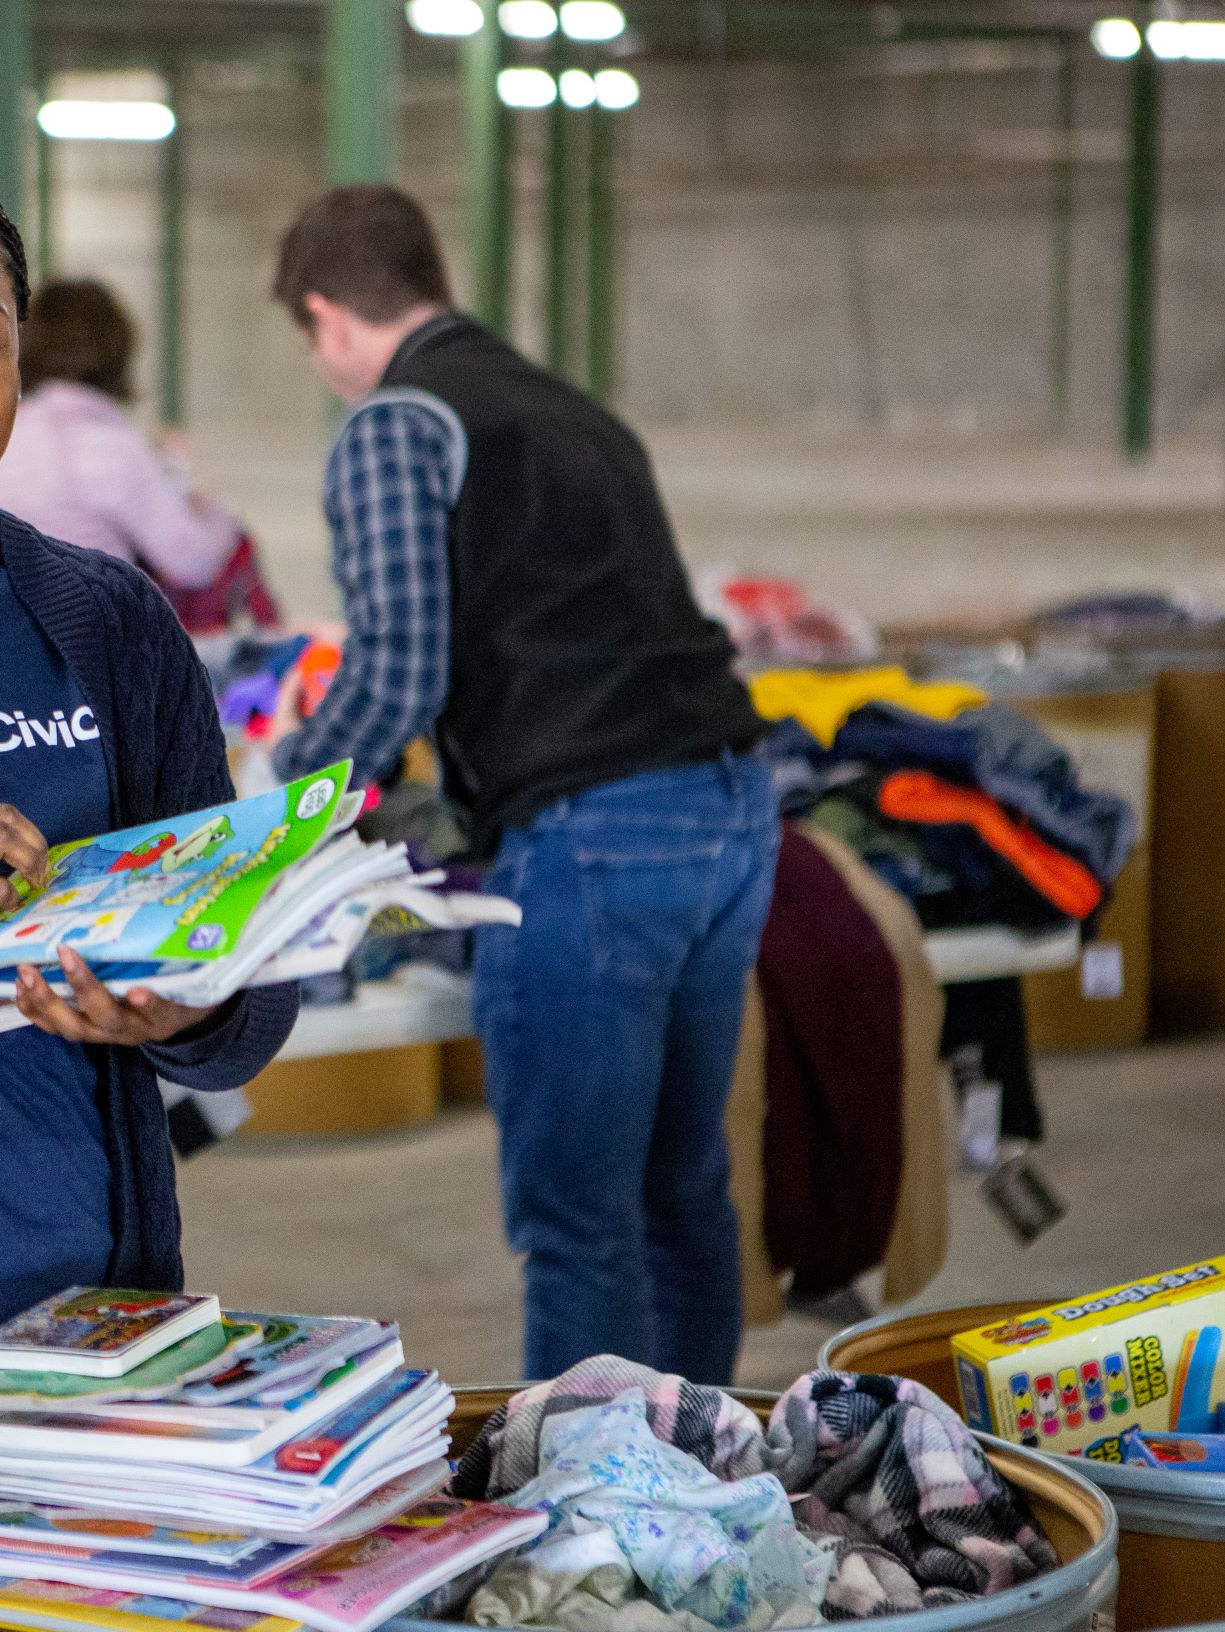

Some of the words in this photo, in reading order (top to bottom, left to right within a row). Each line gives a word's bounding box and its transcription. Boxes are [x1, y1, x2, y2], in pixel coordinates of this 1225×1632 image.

[1053, 1281, 1163, 1321] Dough
[1159, 1263, 1220, 1292] Set
[1127, 1337, 1150, 1406] MIXER
[1143, 1335, 1168, 1401] COLOR
